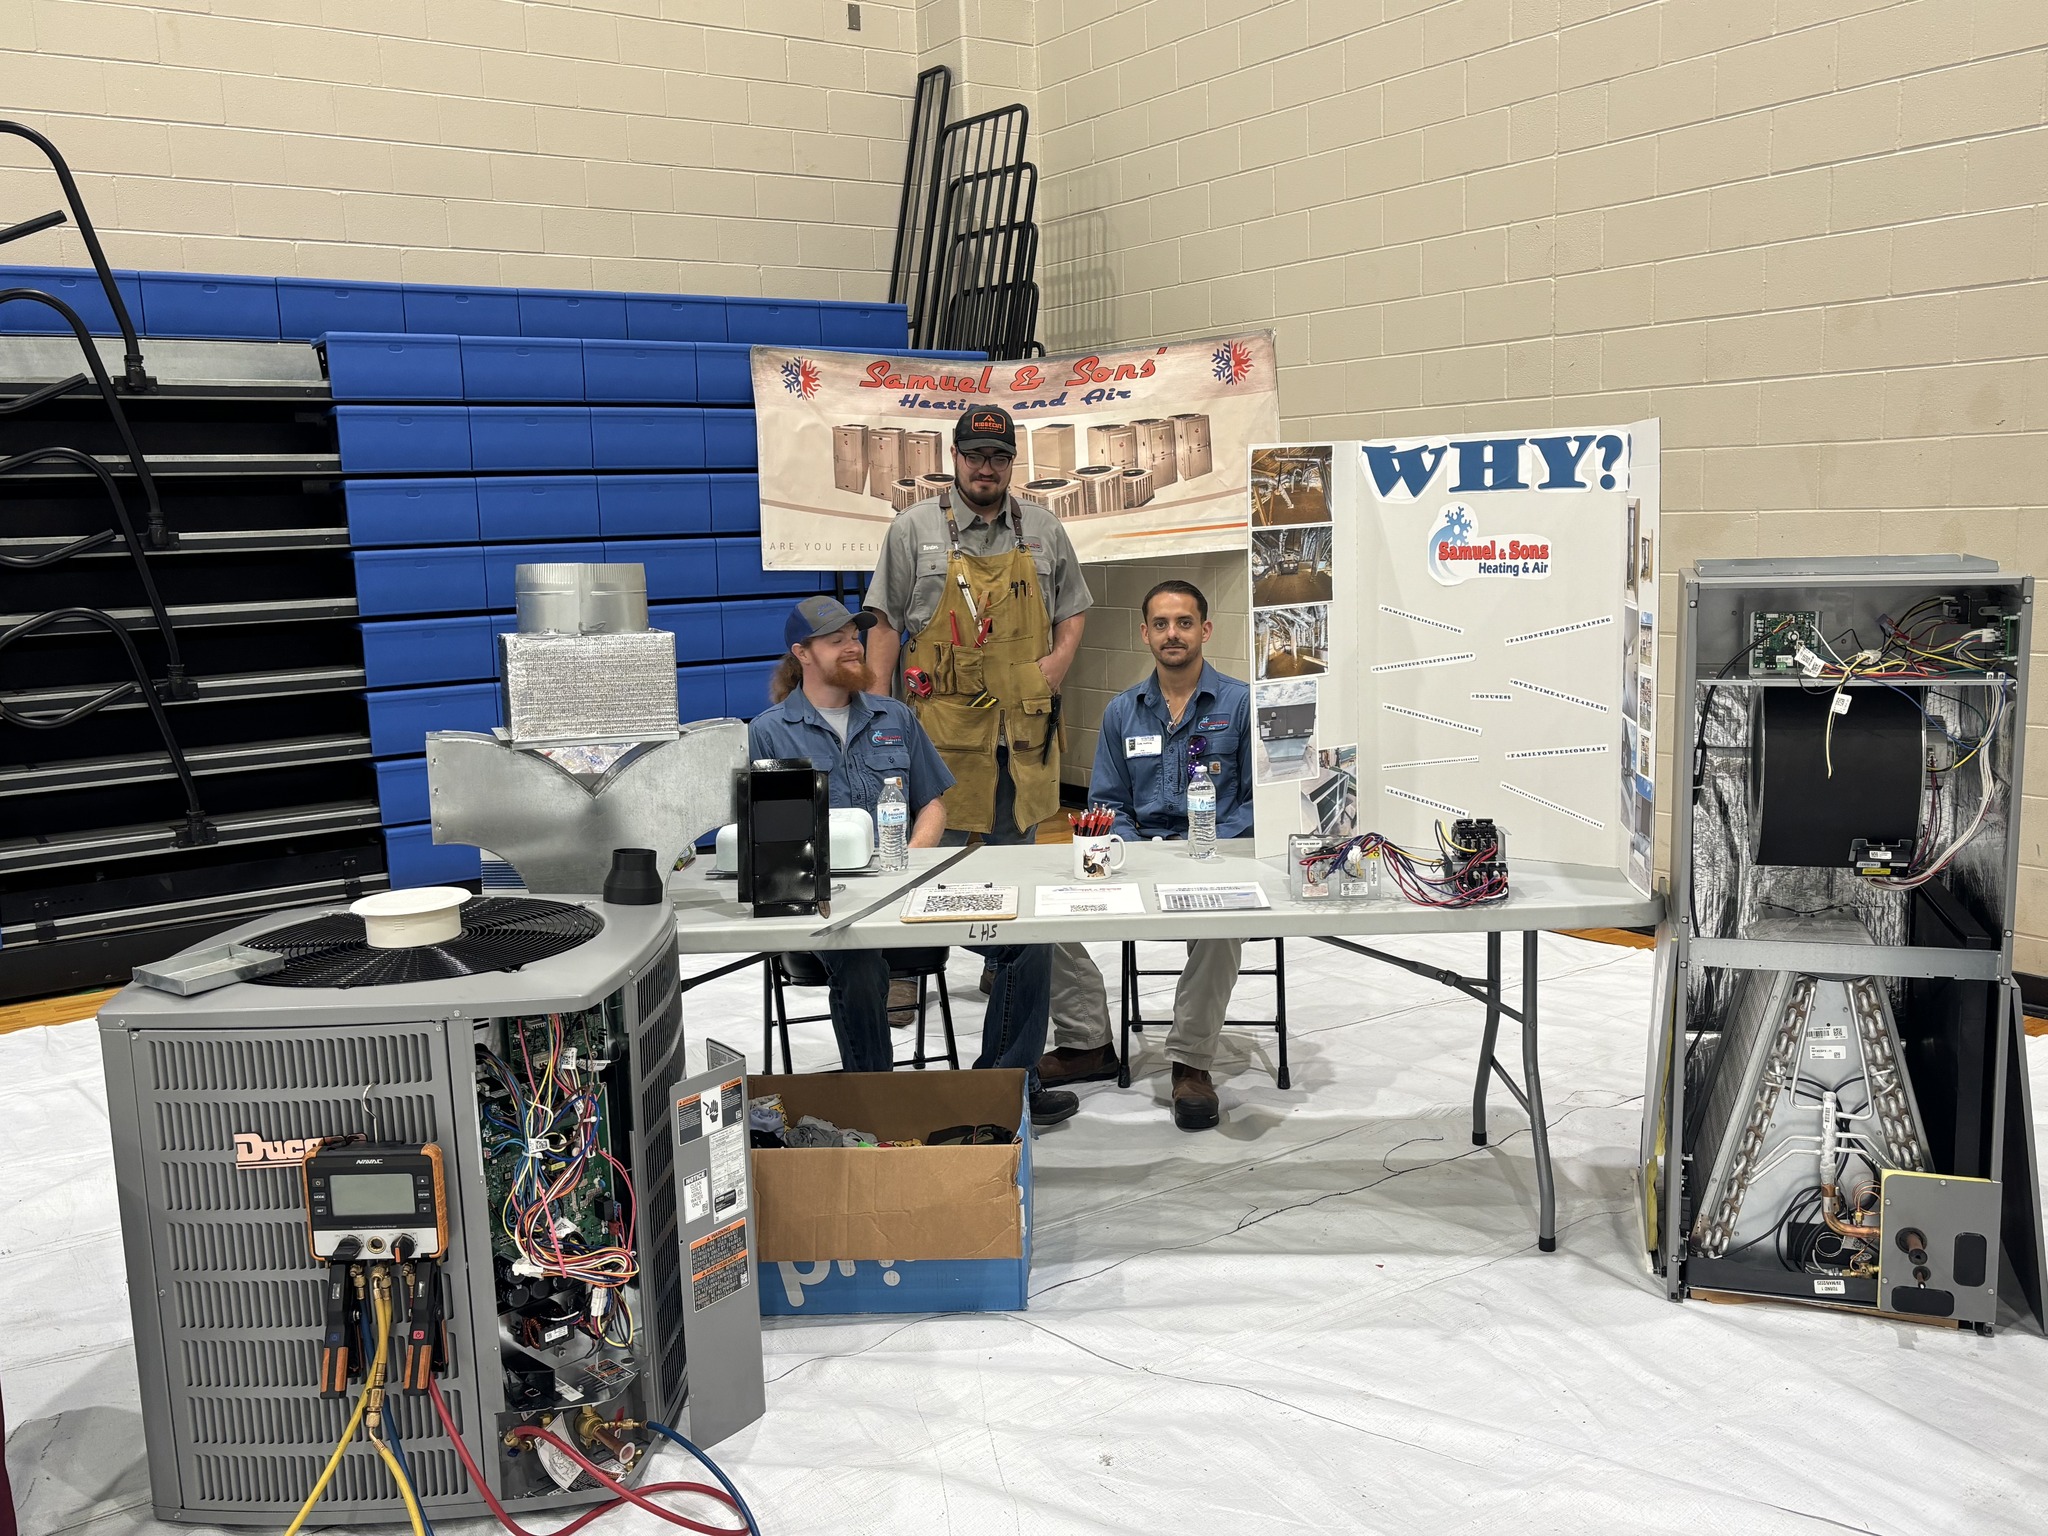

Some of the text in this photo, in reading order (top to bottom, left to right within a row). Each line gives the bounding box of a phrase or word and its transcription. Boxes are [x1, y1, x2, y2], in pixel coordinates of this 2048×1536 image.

[859, 346, 1168, 394] Samuel & Sons'
[898, 387, 1132, 411] Heati and Air
[769, 542, 879, 551] ARE YOU FEELI
[1438, 540, 1549, 560] Samuel & Sons
[1478, 561, 1549, 577] Heating & Air
[1506, 746, 1607, 758] #FAMILYOWNEDCOMPANY
[685, 1171, 706, 1185] NOTICE
[711, 1226, 731, 1238] WARNING
